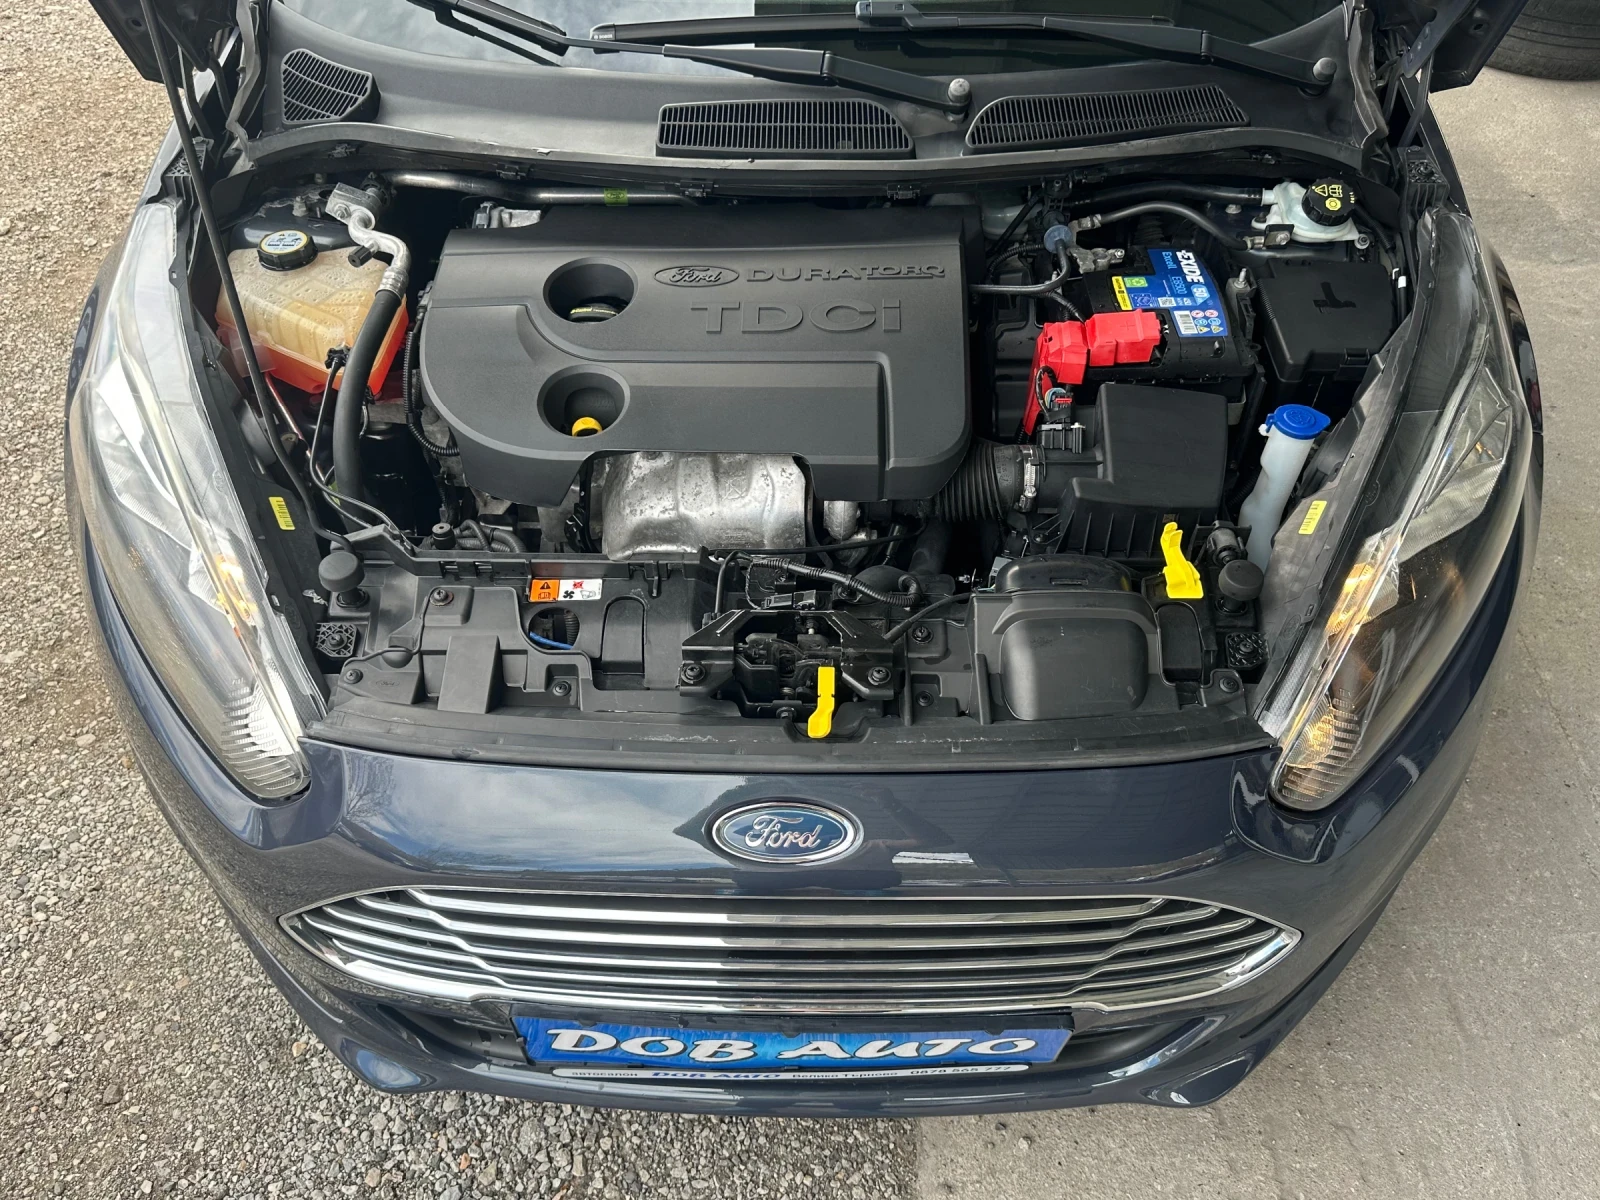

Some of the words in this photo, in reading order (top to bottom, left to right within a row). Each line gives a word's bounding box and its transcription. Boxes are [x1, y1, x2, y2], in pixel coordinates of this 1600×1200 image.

[1162, 251, 1177, 269] Excell
[1176, 249, 1205, 284] EXIDE
[668, 267, 723, 283] Ford
[746, 265, 946, 282] DURATORQ
[1193, 287, 1207, 298] 50
[744, 814, 823, 848] Ford
[547, 1029, 758, 1063] DOB
